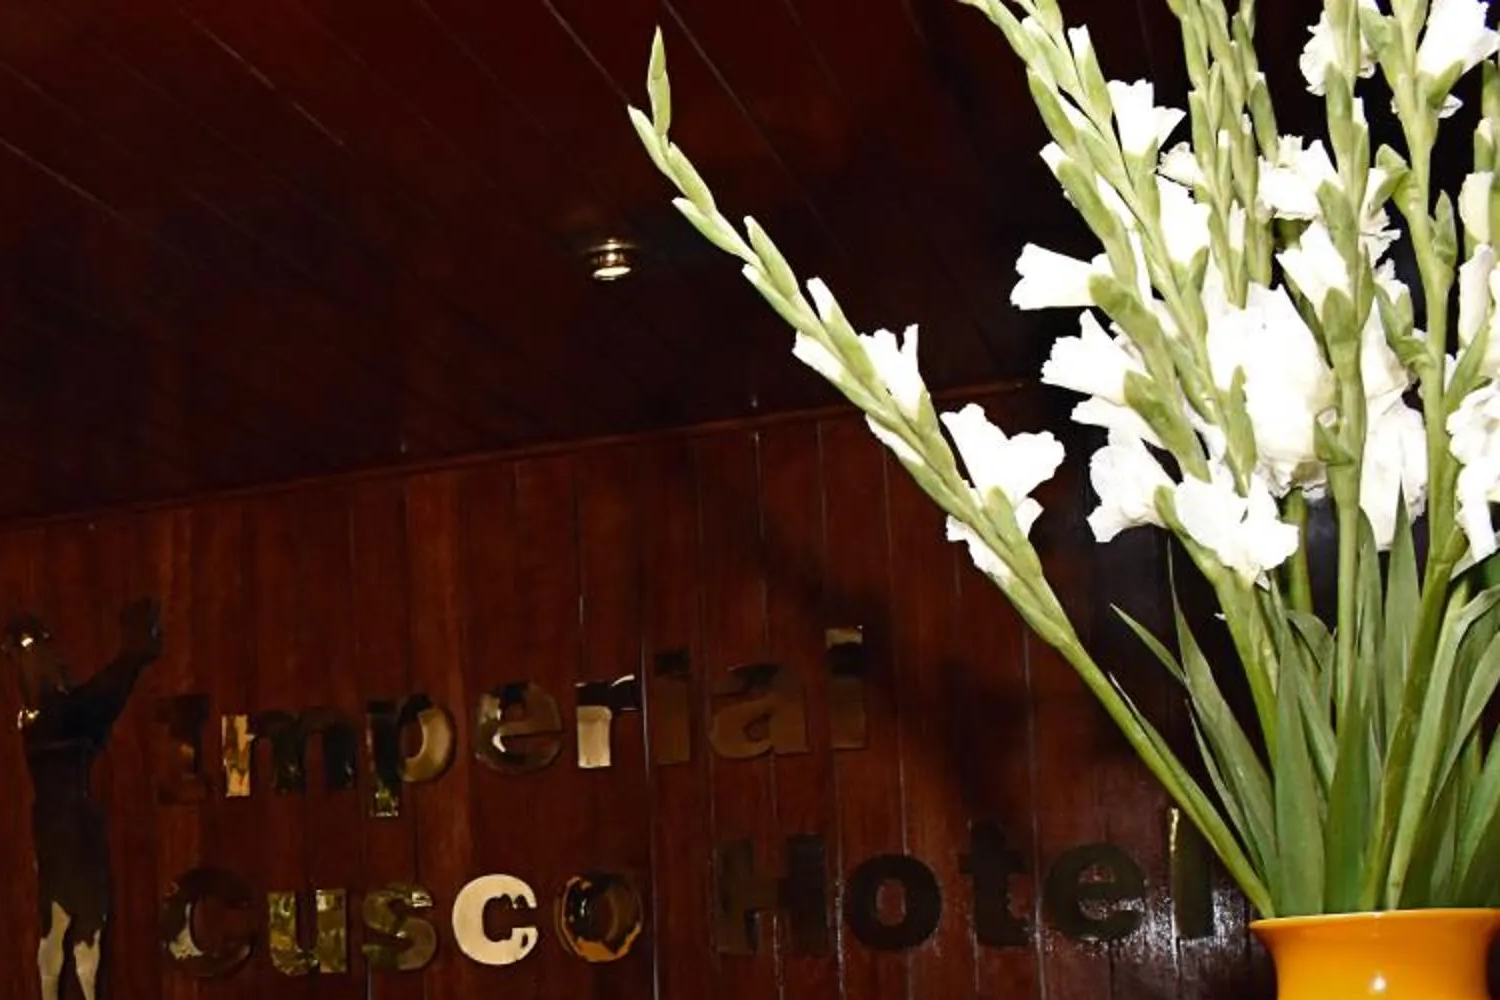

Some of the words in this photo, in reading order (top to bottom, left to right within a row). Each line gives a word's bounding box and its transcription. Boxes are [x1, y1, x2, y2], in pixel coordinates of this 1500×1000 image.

[153, 624, 868, 818] Imperial
[162, 866, 645, 977] Cusco
[712, 806, 1215, 957] Hotel
